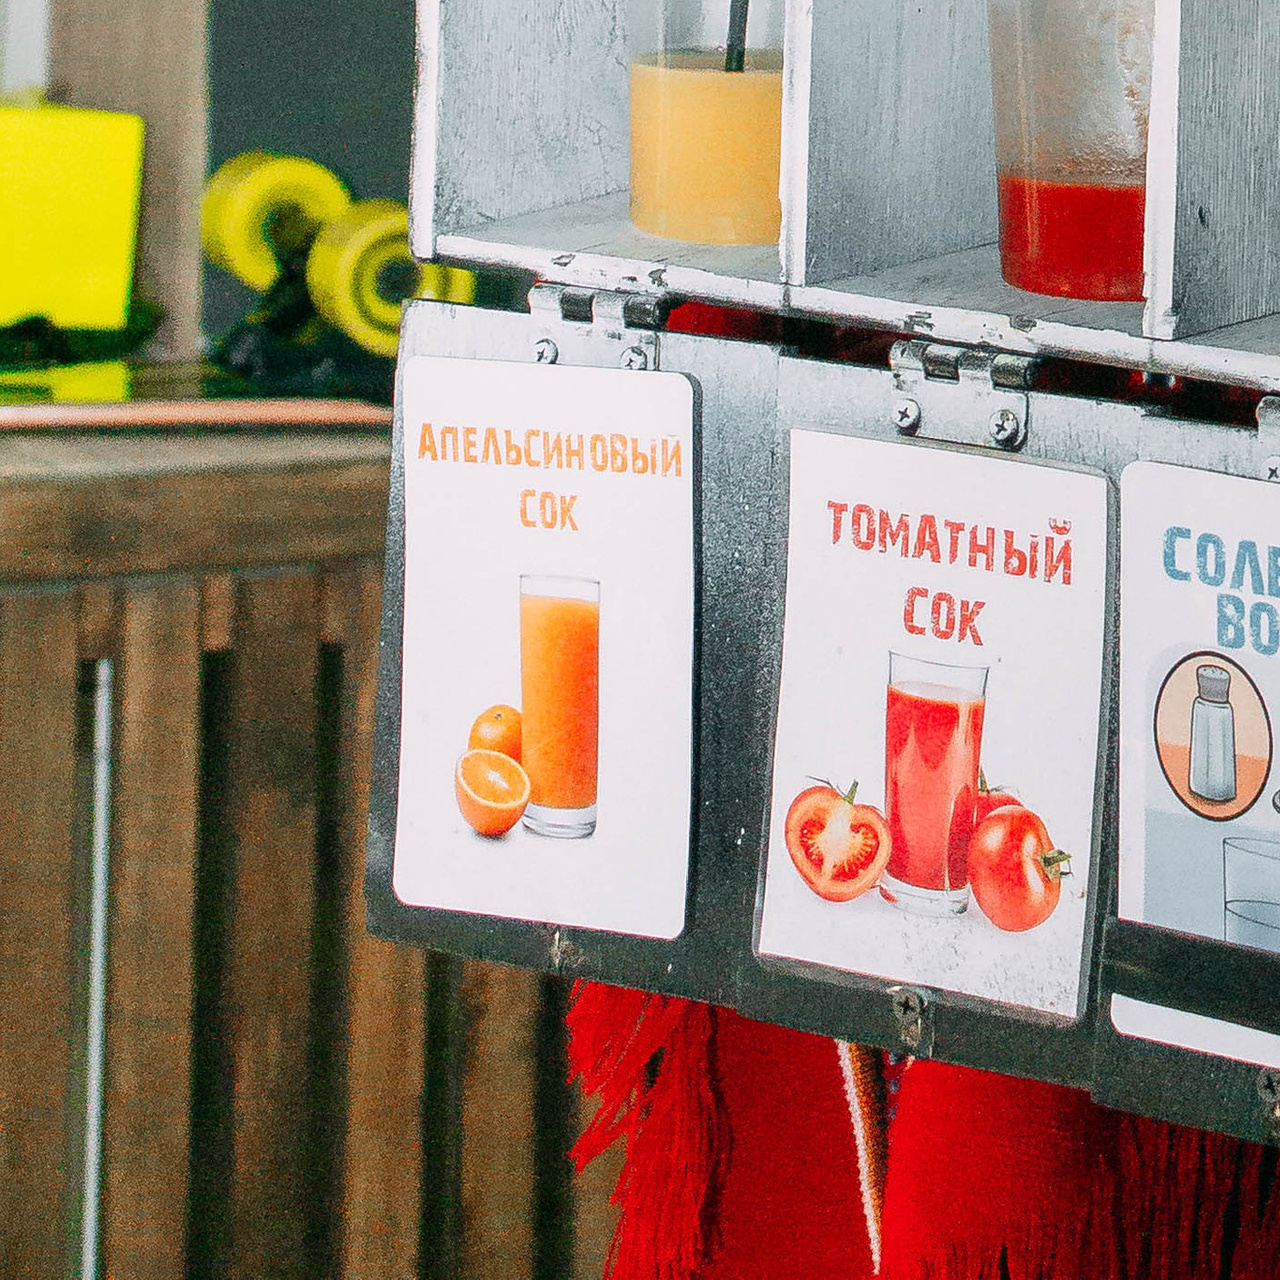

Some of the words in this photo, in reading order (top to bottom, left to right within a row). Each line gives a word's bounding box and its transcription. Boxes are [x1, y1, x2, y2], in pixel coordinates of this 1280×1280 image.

[417, 422, 683, 478] АПЕЛЬСИНОВЫЙ
[519, 488, 580, 532] СОК
[827, 500, 1073, 586] ТОМАТНЫЙ
[903, 586, 987, 647] СОК
